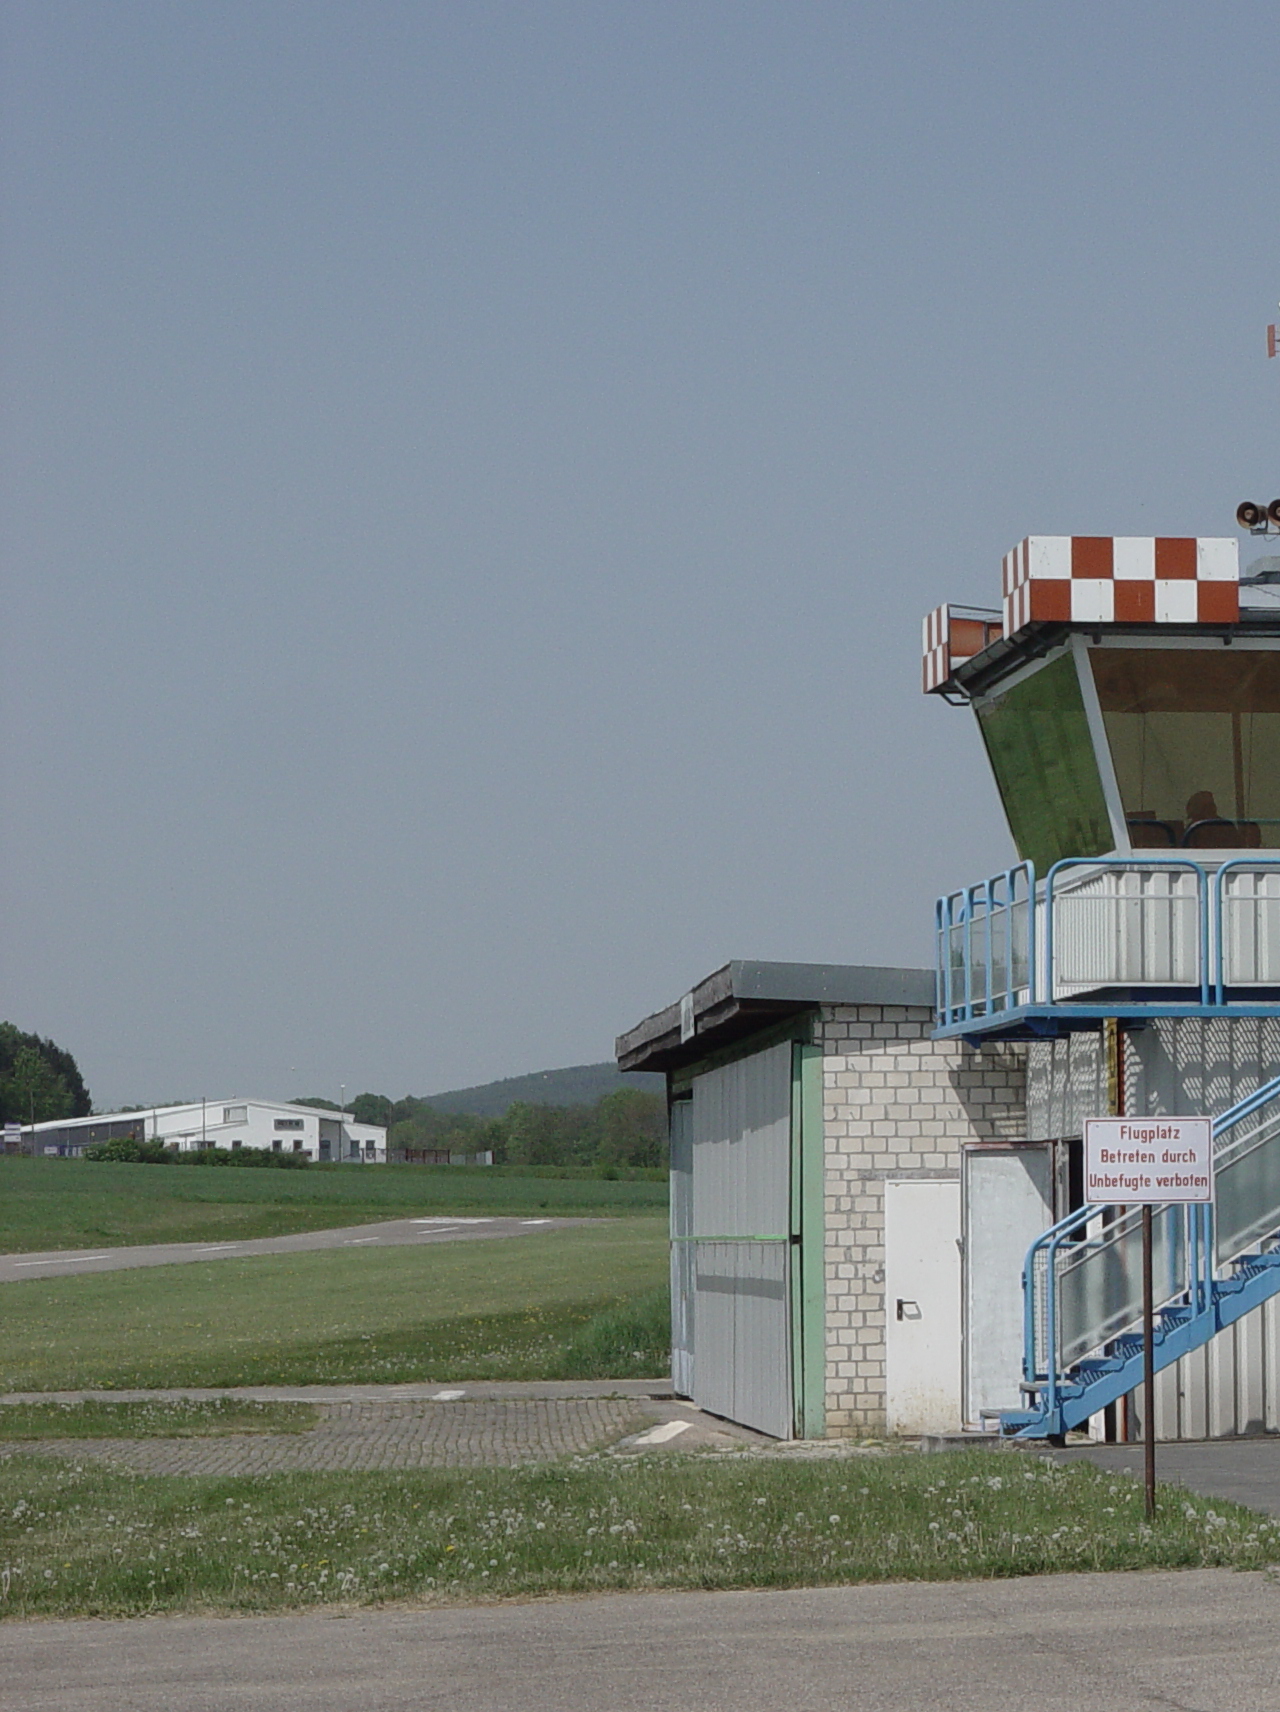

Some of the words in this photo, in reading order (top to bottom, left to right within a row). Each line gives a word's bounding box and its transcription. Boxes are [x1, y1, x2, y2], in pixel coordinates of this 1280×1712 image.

[1120, 1125, 1180, 1143] Flugplatz
[1100, 1149, 1155, 1163] Betreten
[1162, 1149, 1196, 1163] durch
[1089, 1173, 1151, 1191] Unbefugte
[1156, 1173, 1207, 1187] verboten
